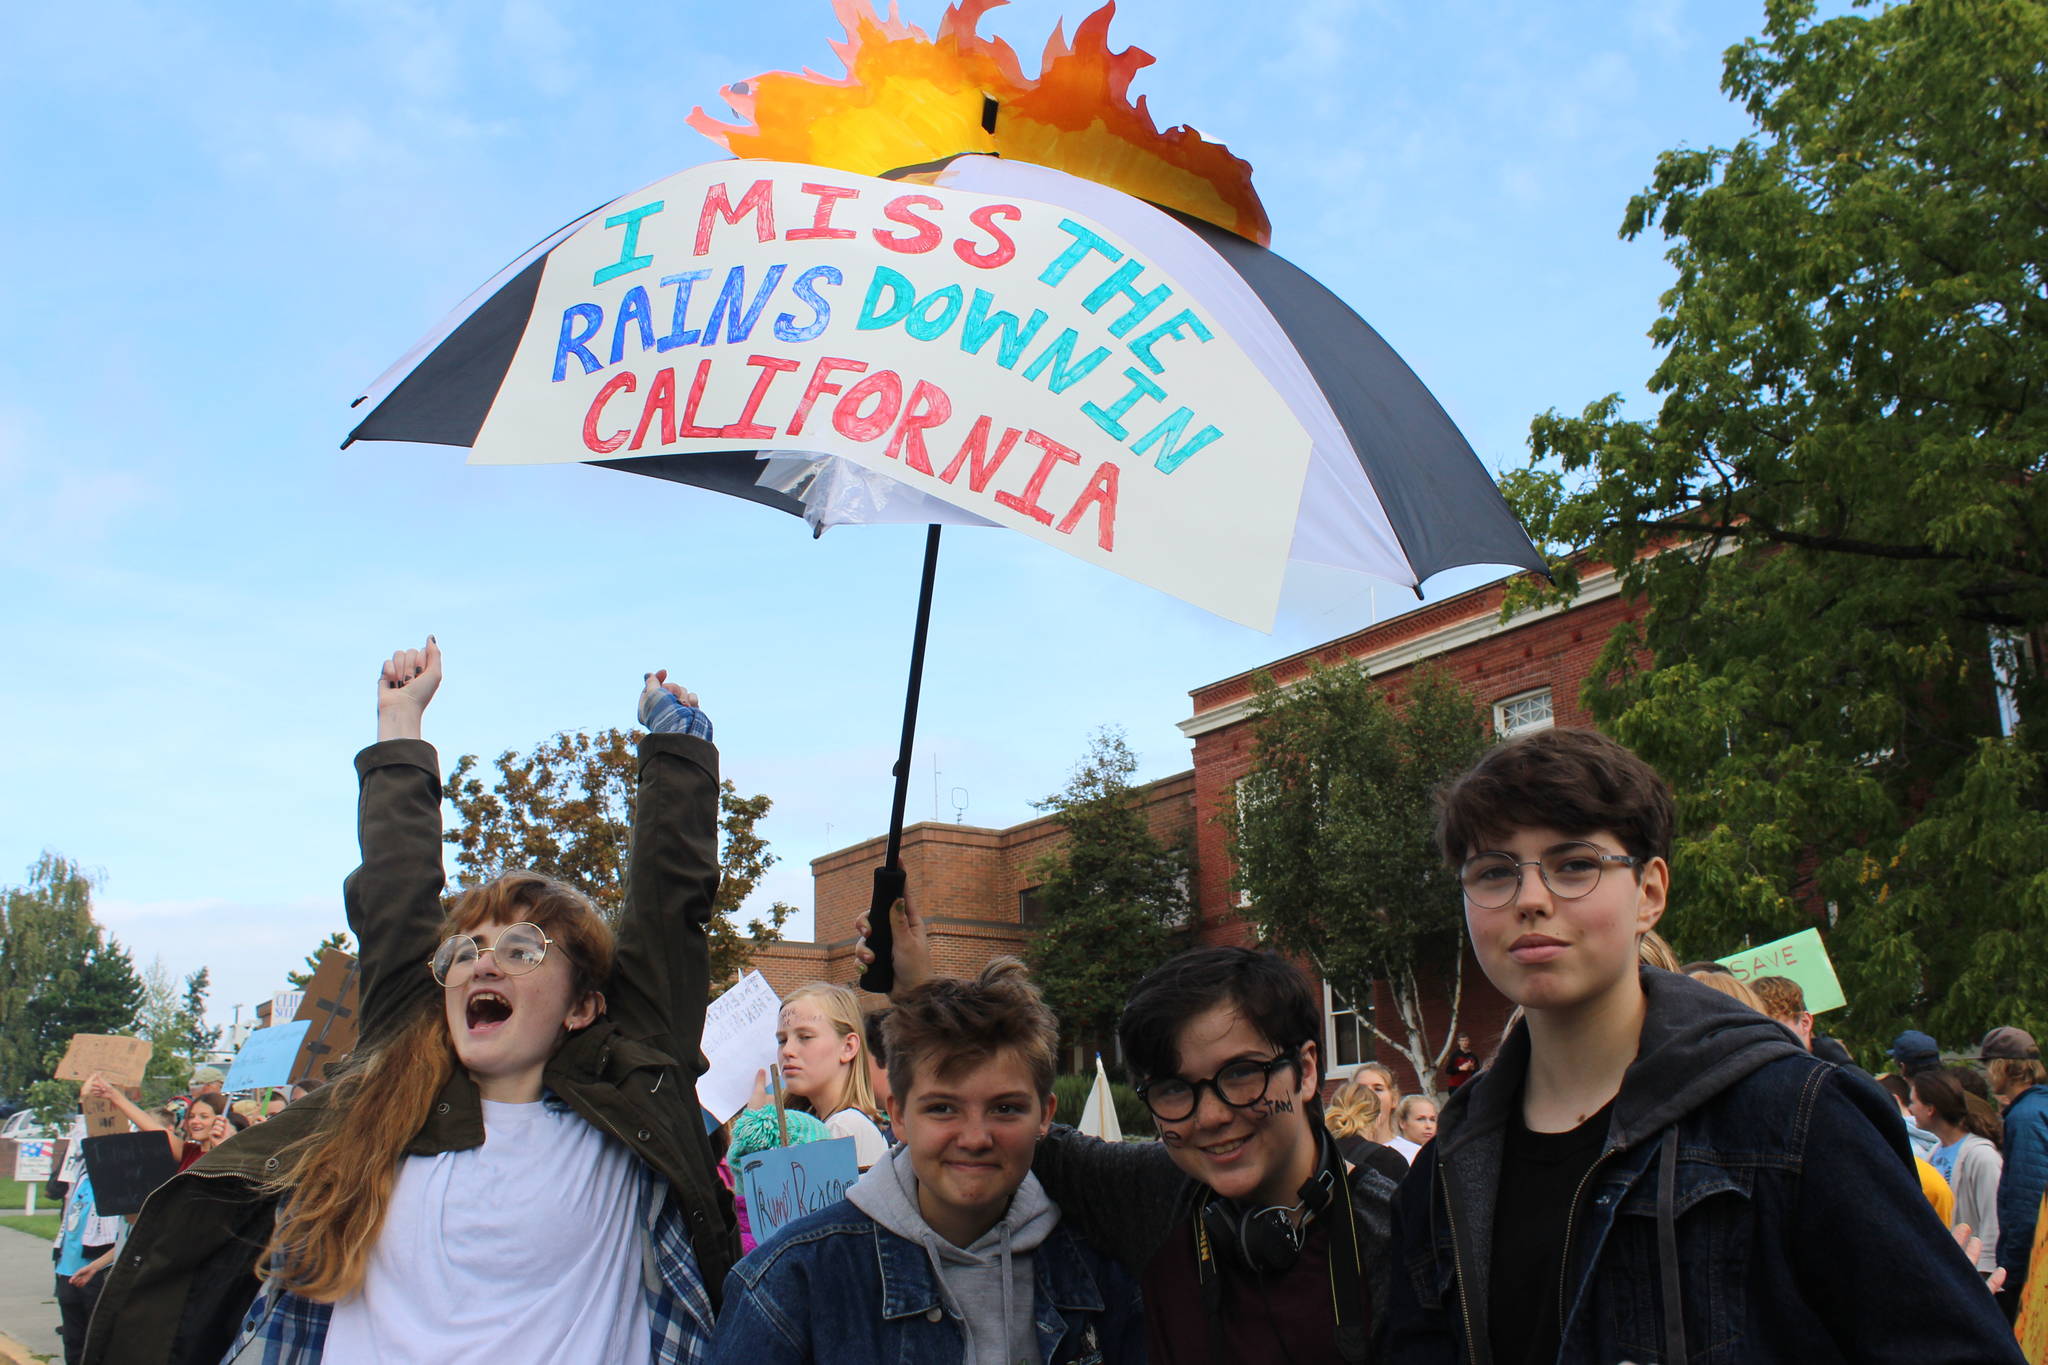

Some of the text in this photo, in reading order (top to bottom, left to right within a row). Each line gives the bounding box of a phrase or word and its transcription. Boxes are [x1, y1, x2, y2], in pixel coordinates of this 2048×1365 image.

[552, 264, 1224, 475] RAINS DOWN IN
[593, 179, 1214, 375] I MISS THE
[582, 355, 1119, 553] CALIFORNIA
[1729, 945, 1797, 981] SAVE
